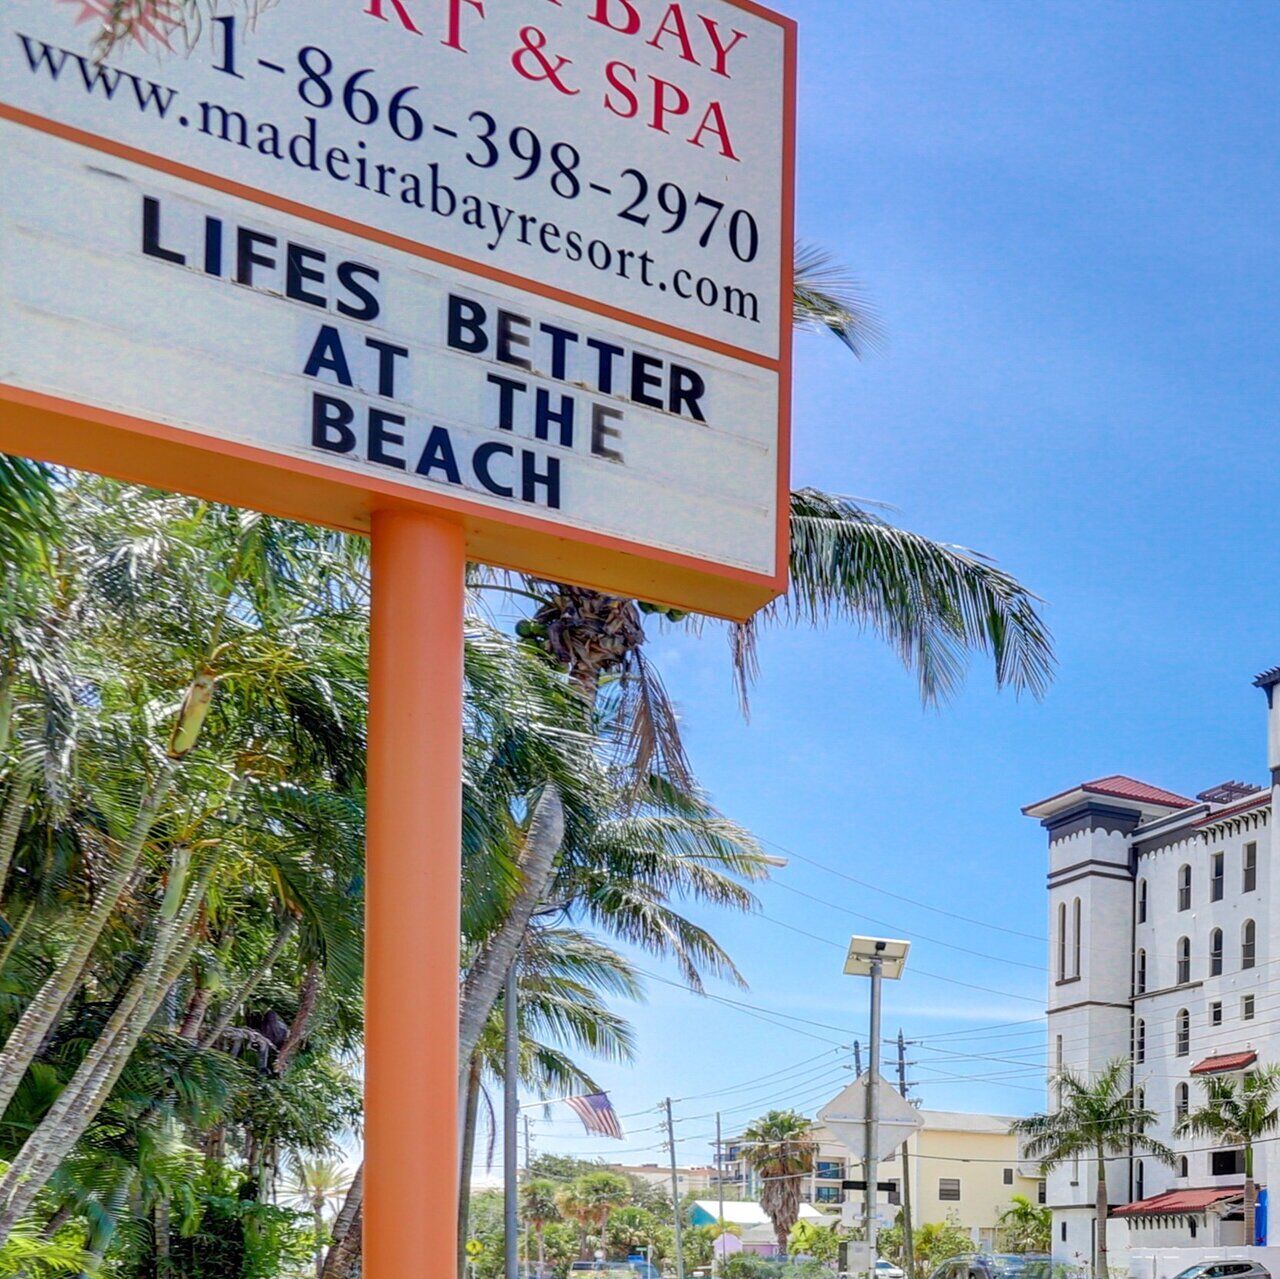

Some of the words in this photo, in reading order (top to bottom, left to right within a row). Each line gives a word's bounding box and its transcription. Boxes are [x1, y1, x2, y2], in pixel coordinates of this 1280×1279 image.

[17, 33, 761, 324] www.madeirabayresort.com
[210, 16, 759, 263] 1-866-398-2970
[511, 26, 580, 95] &
[604, 61, 741, 161] SPA
[142, 195, 381, 322] LIFES
[446, 292, 707, 423] BETTER
[302, 323, 409, 399] AT
[486, 371, 625, 463] THE
[311, 391, 561, 510] BEACH
